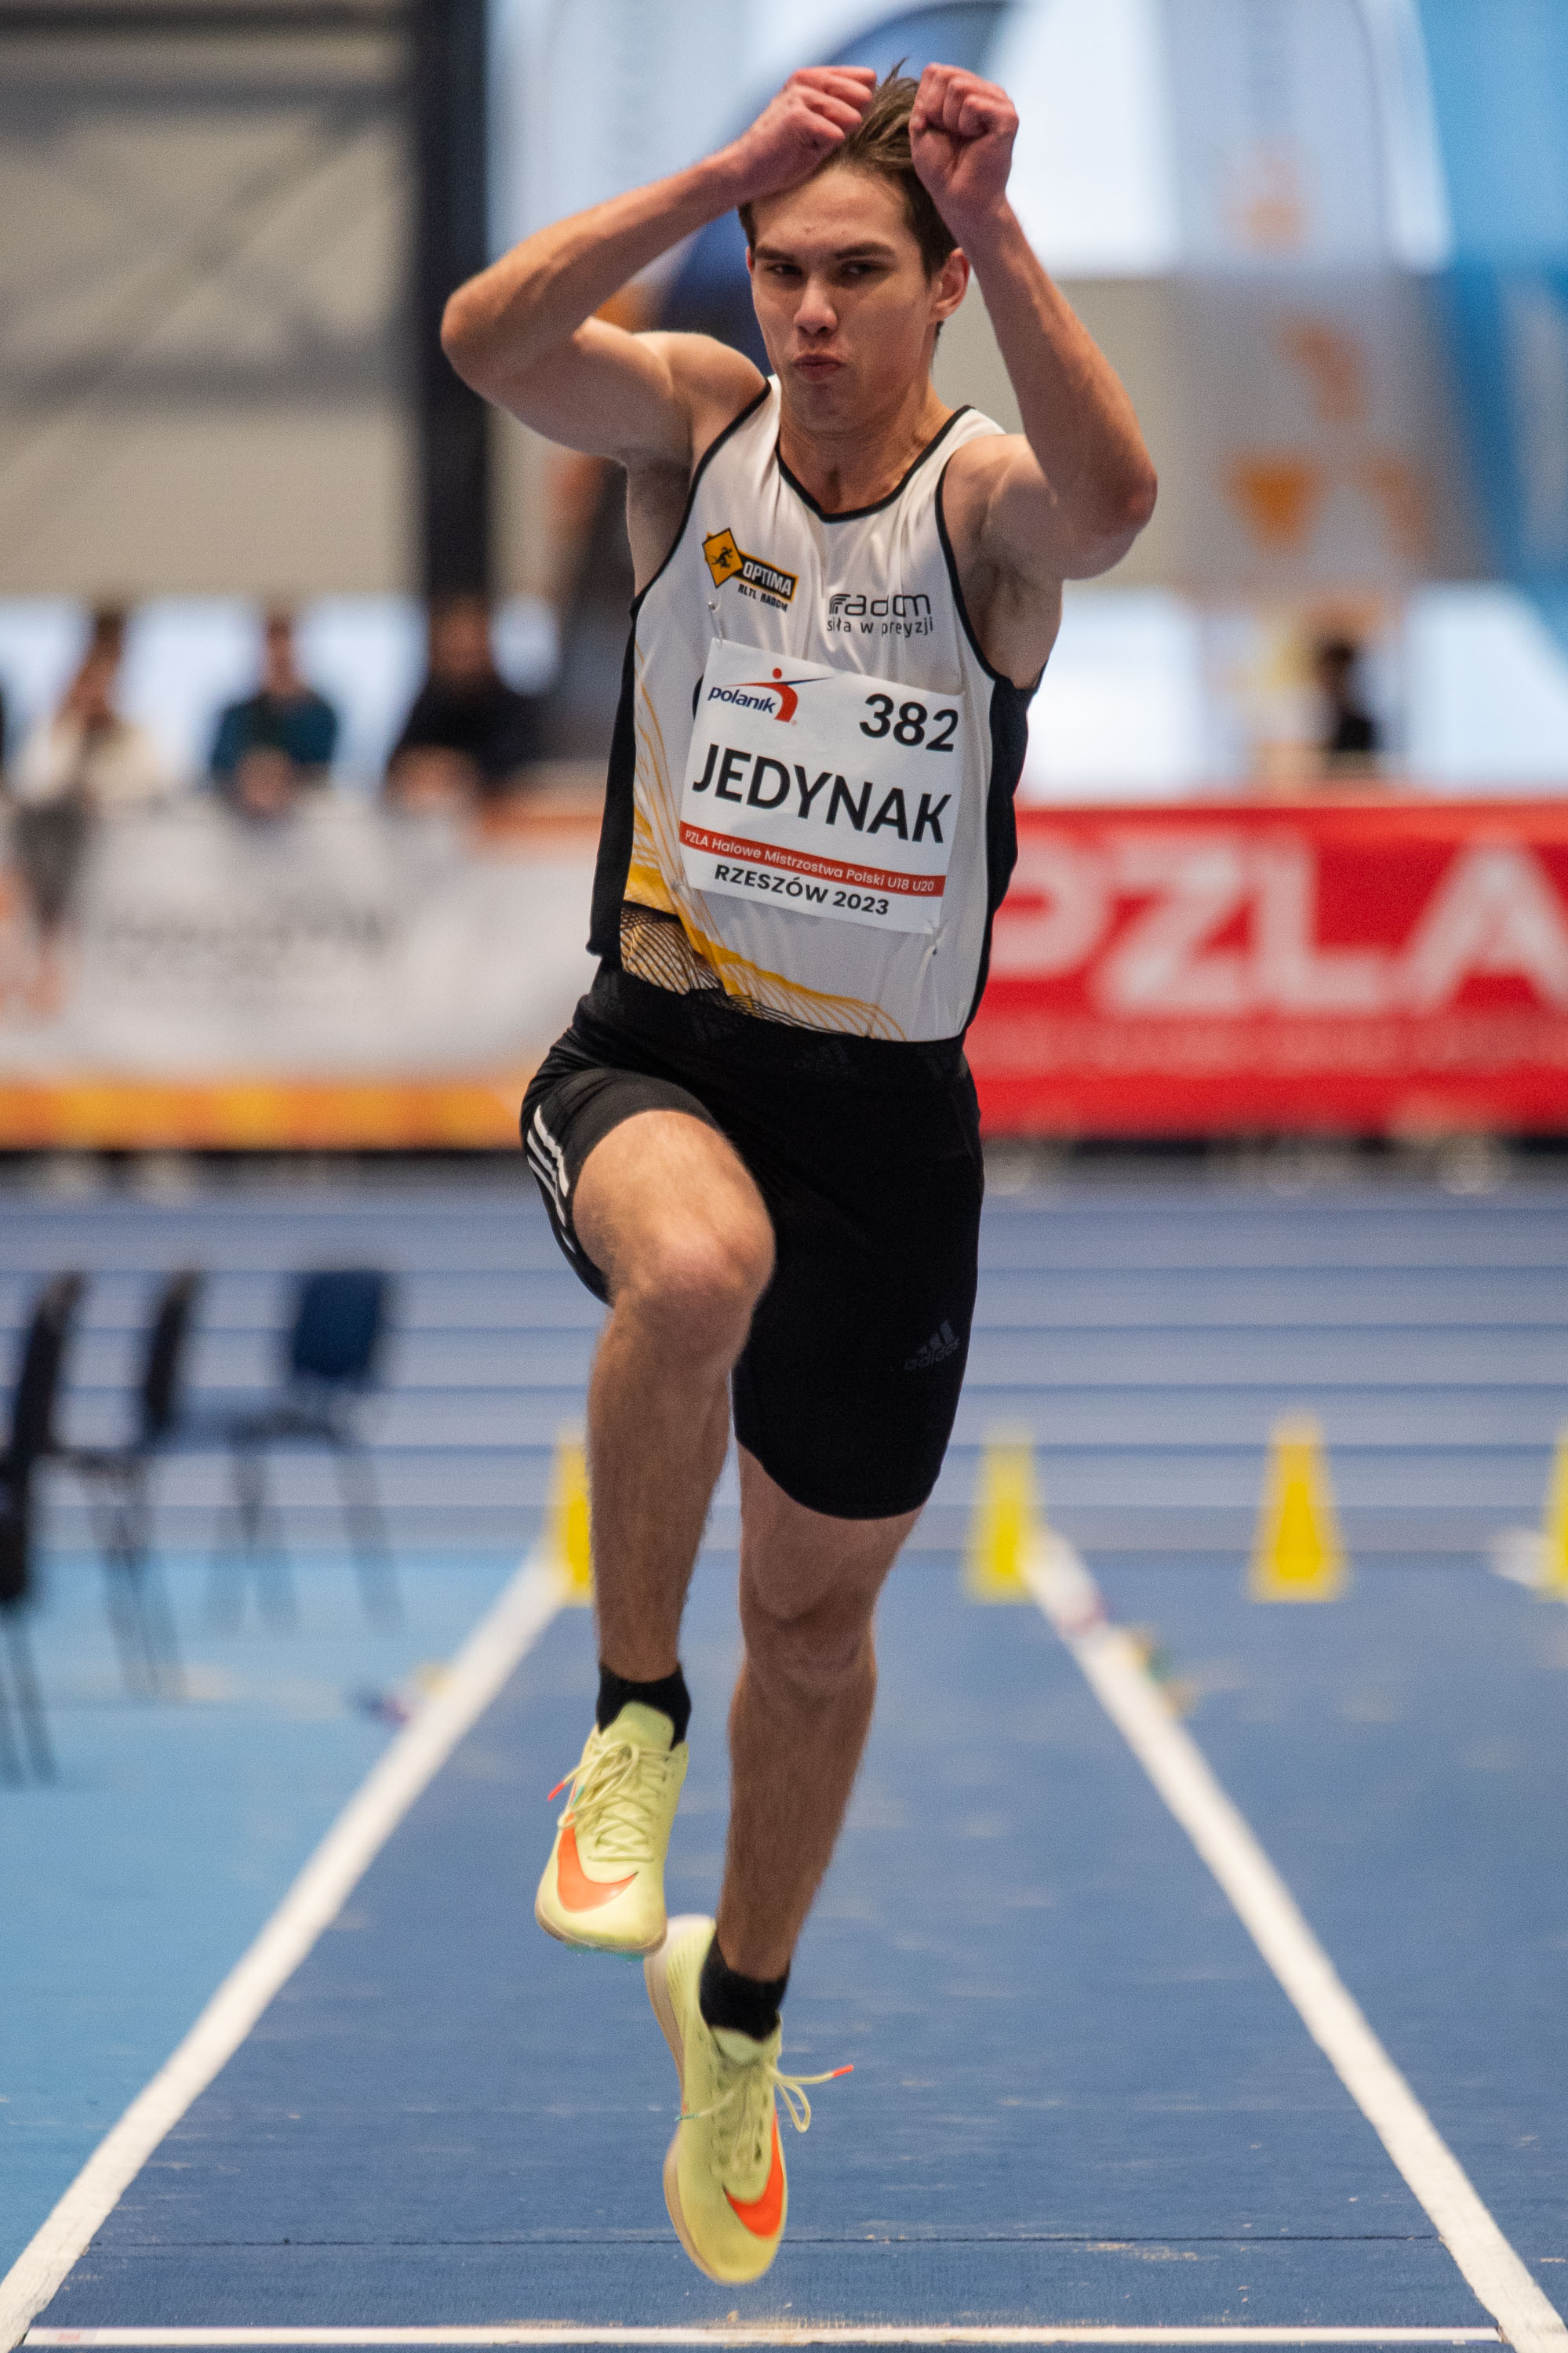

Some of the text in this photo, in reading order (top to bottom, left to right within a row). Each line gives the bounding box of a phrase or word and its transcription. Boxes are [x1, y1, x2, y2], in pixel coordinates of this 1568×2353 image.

[742, 561, 791, 596] OPTIMA
[860, 622, 874, 634] w
[707, 686, 777, 714] polanik
[859, 693, 959, 752] 382
[692, 743, 952, 844] JEDYNAK
[685, 829, 935, 893] PZLA Halowe Mistrzostwa Polski U18 U20
[715, 864, 890, 916] RZESZÓW 2023
